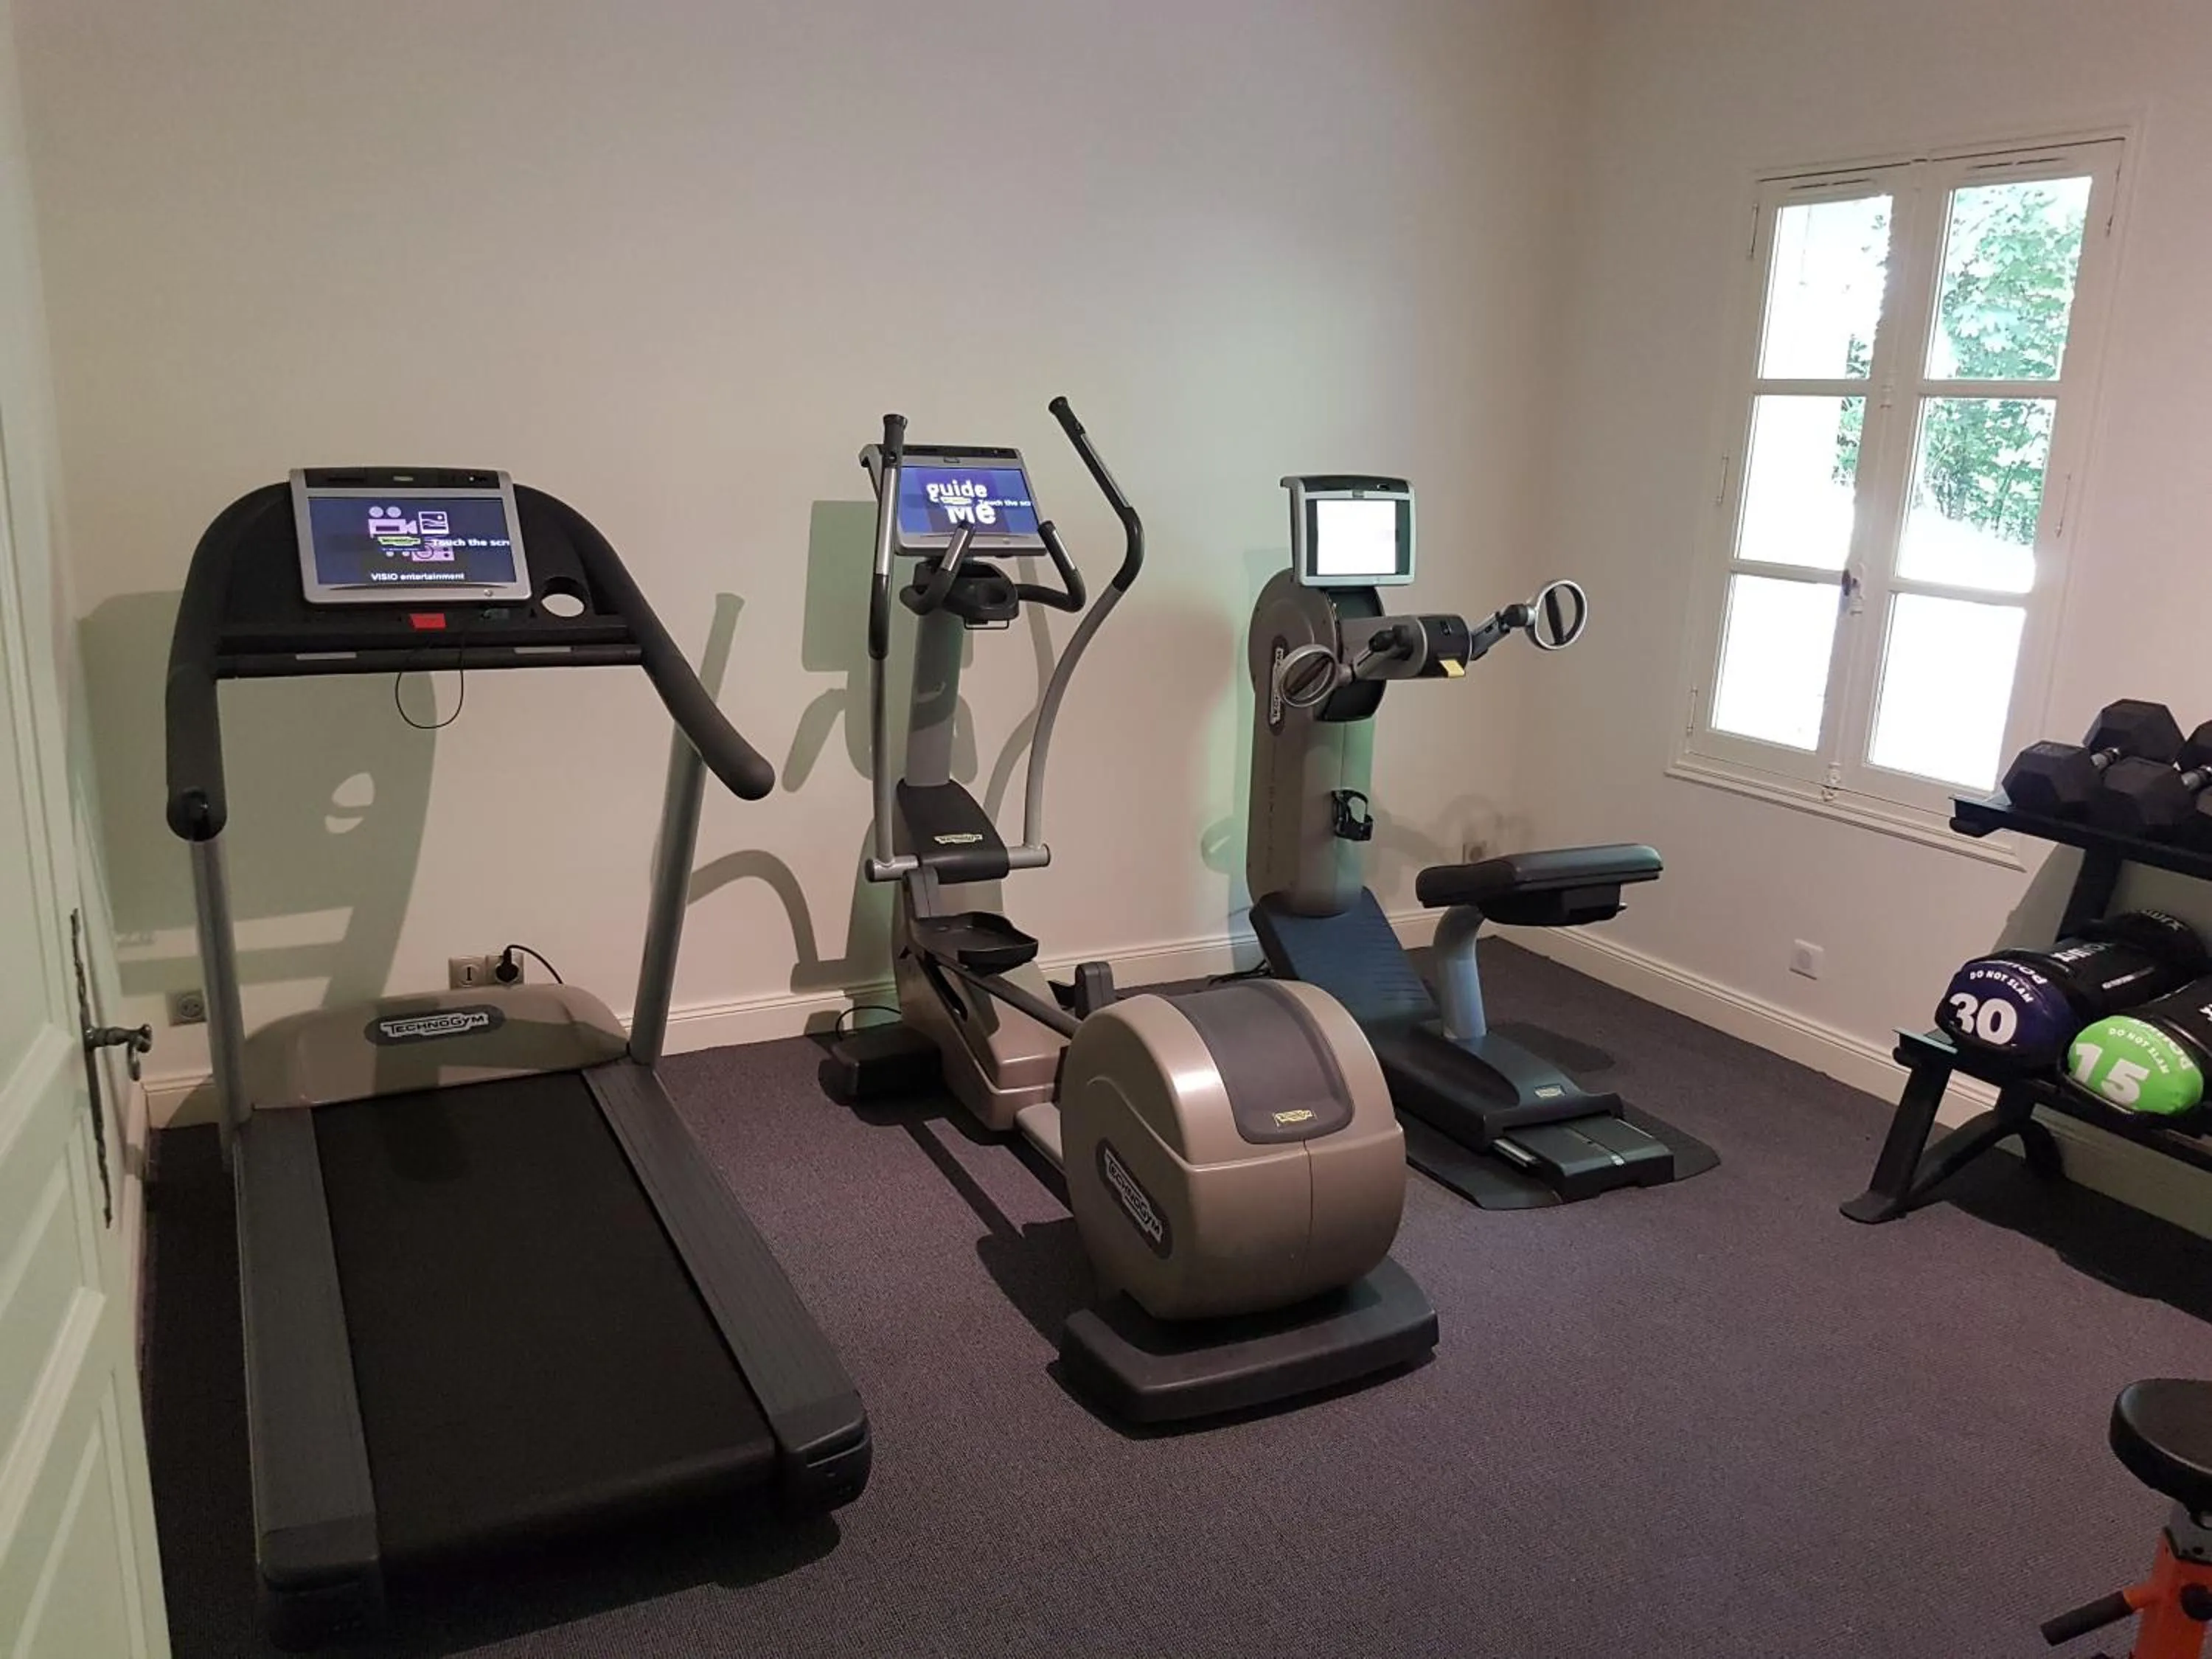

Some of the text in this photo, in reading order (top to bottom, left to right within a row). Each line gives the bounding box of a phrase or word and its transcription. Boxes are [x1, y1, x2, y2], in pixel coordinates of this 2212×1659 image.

[927, 479, 987, 503] guide
[433, 538, 466, 546] Touch
[467, 538, 488, 546] the
[371, 572, 465, 581] VISIO entertainment
[1969, 970, 1984, 980] DO
[1986, 970, 2008, 981] NOT
[2007, 978, 2034, 1003] SLAM
[1949, 992, 2017, 1045] 30
[2109, 1027, 2170, 1074] DO NOT SLAM
[2075, 1042, 2150, 1105] 15
